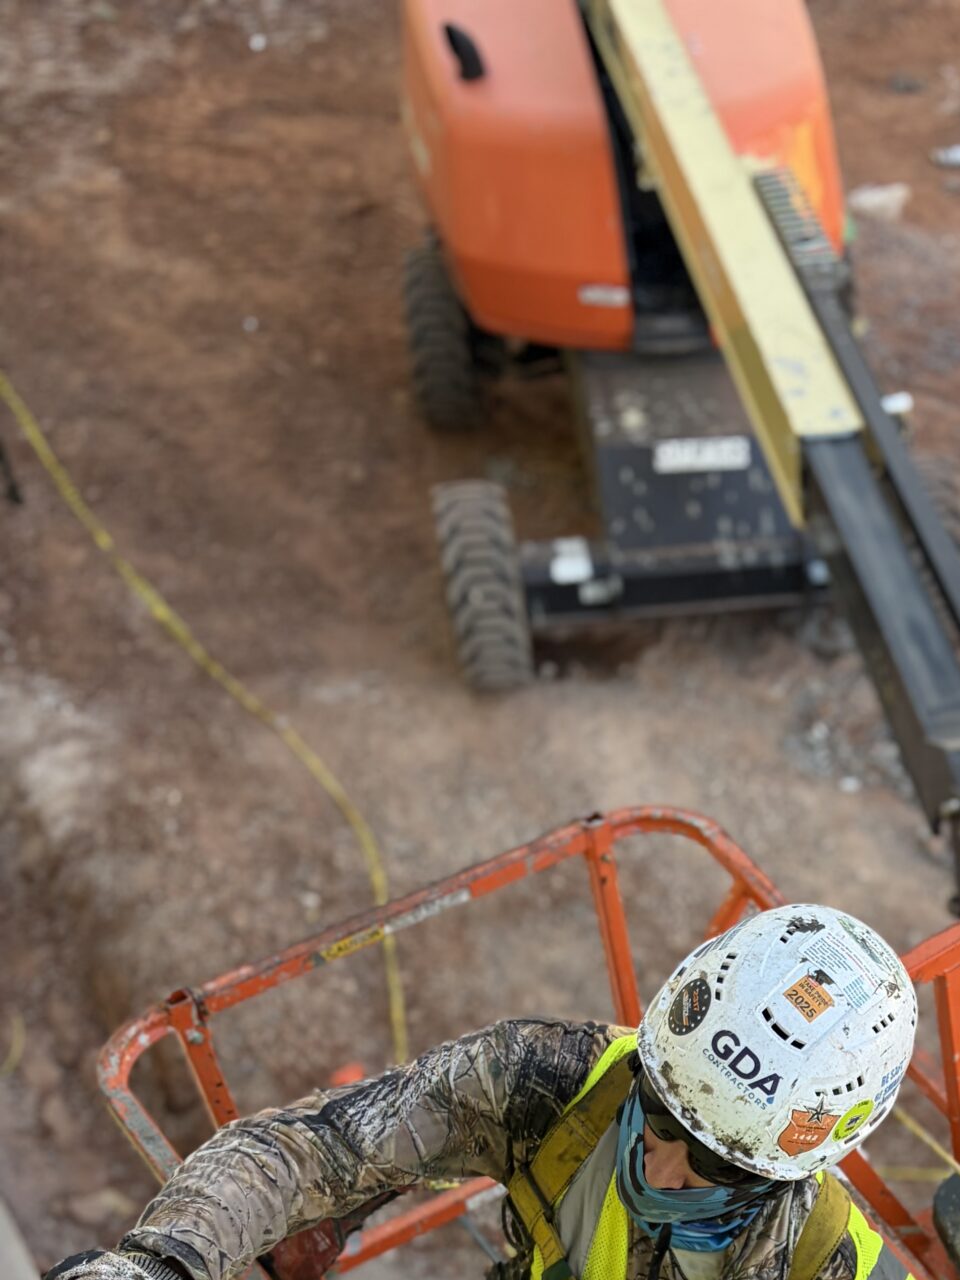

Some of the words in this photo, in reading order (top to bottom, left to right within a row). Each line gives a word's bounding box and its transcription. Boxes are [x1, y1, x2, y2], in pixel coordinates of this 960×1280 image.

[787, 989, 817, 1018] 2025
[702, 1048, 768, 1111] CONTRACTORS
[711, 1029, 781, 1096] GDA
